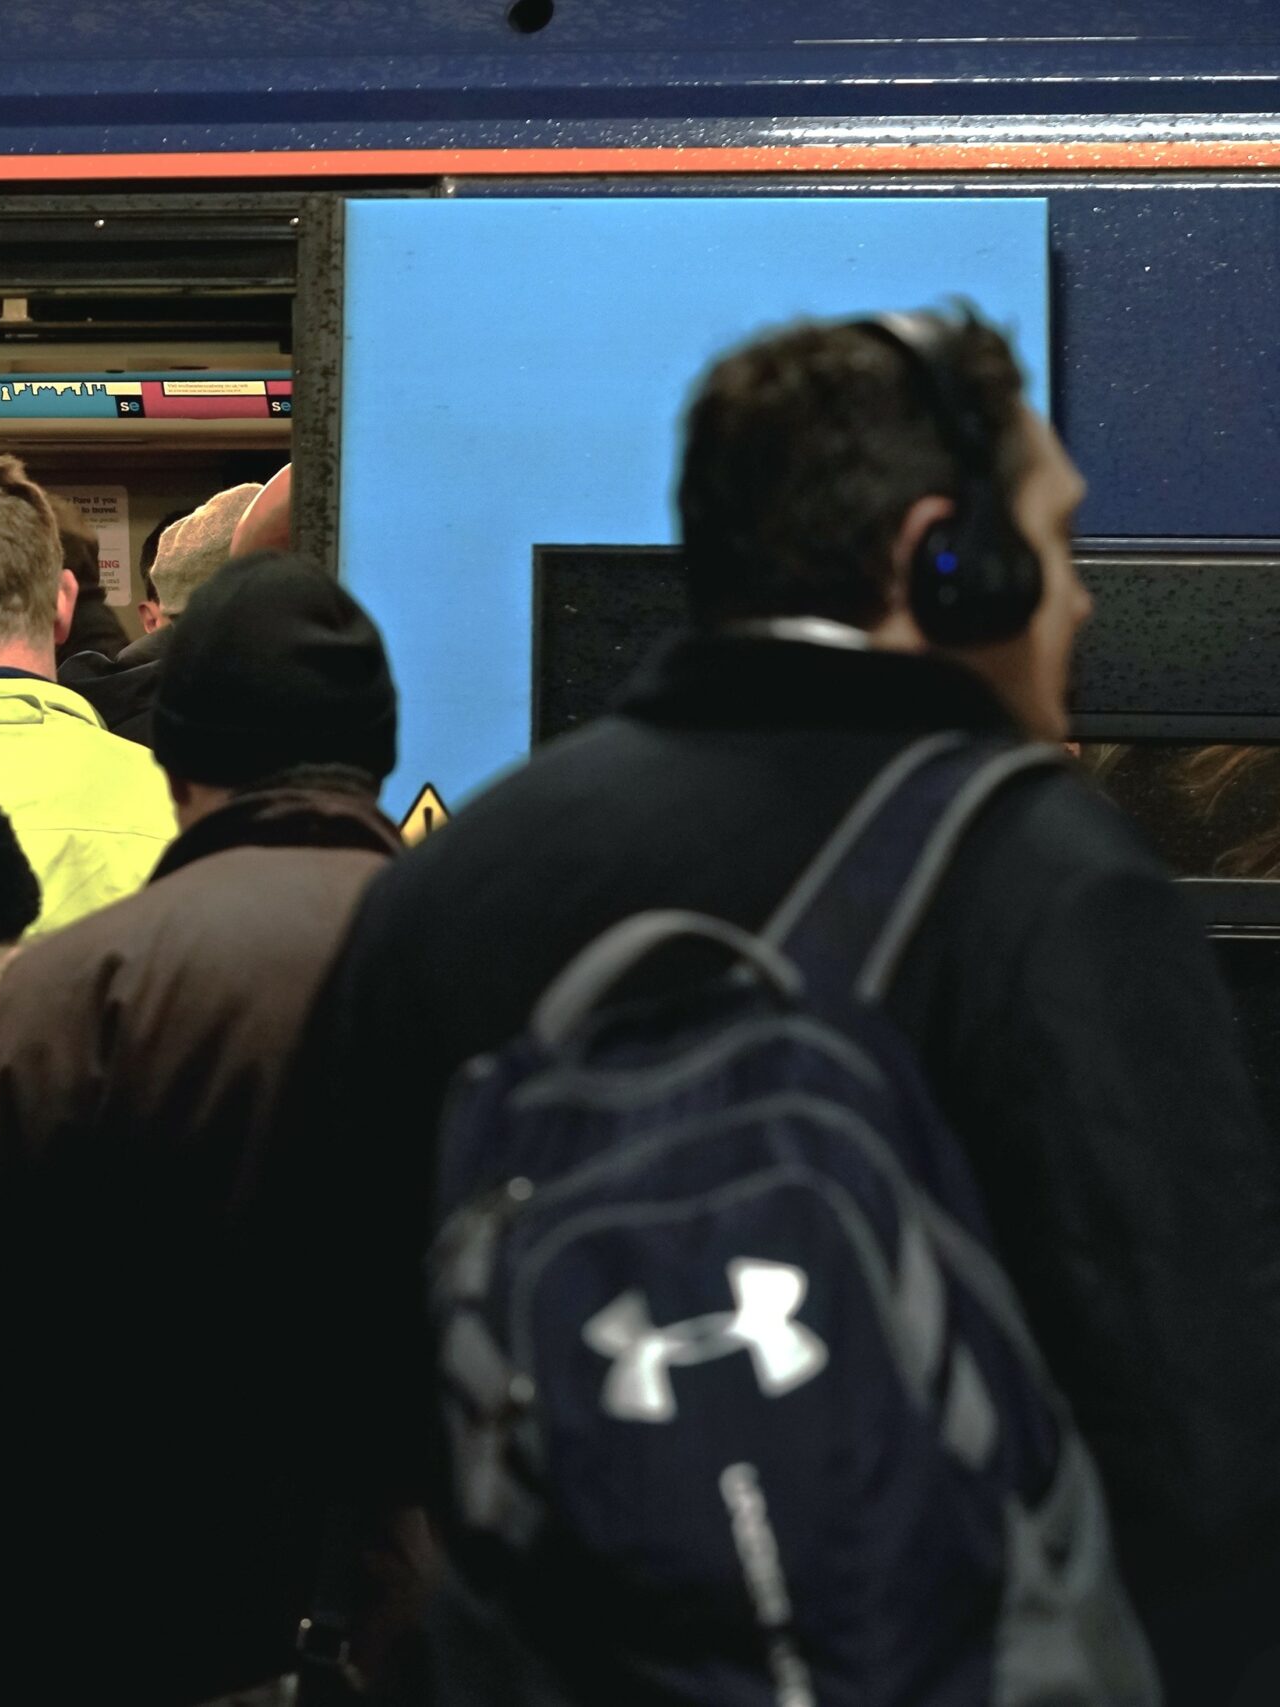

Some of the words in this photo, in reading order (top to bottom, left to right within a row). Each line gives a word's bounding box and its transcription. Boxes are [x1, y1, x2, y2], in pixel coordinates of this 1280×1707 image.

[120, 401, 140, 412] se
[271, 401, 292, 412] se
[101, 497, 117, 506] you
